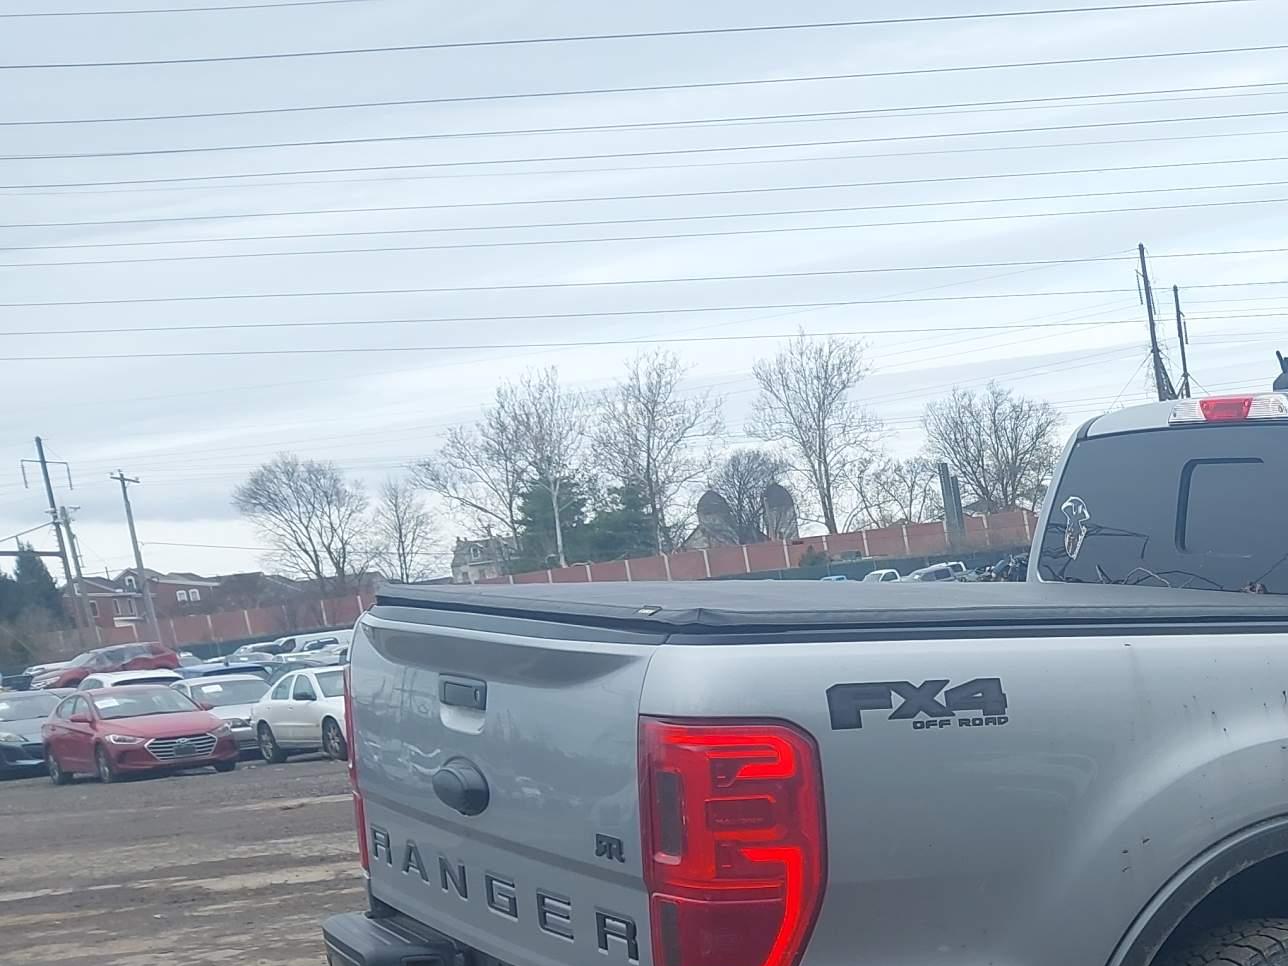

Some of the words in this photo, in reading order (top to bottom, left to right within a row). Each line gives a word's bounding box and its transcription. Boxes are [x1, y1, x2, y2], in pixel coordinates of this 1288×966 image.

[825, 677, 1008, 730] FX4
[912, 718, 952, 729] OFF
[958, 716, 1009, 728] ROAD
[370, 825, 639, 965] RANGER
